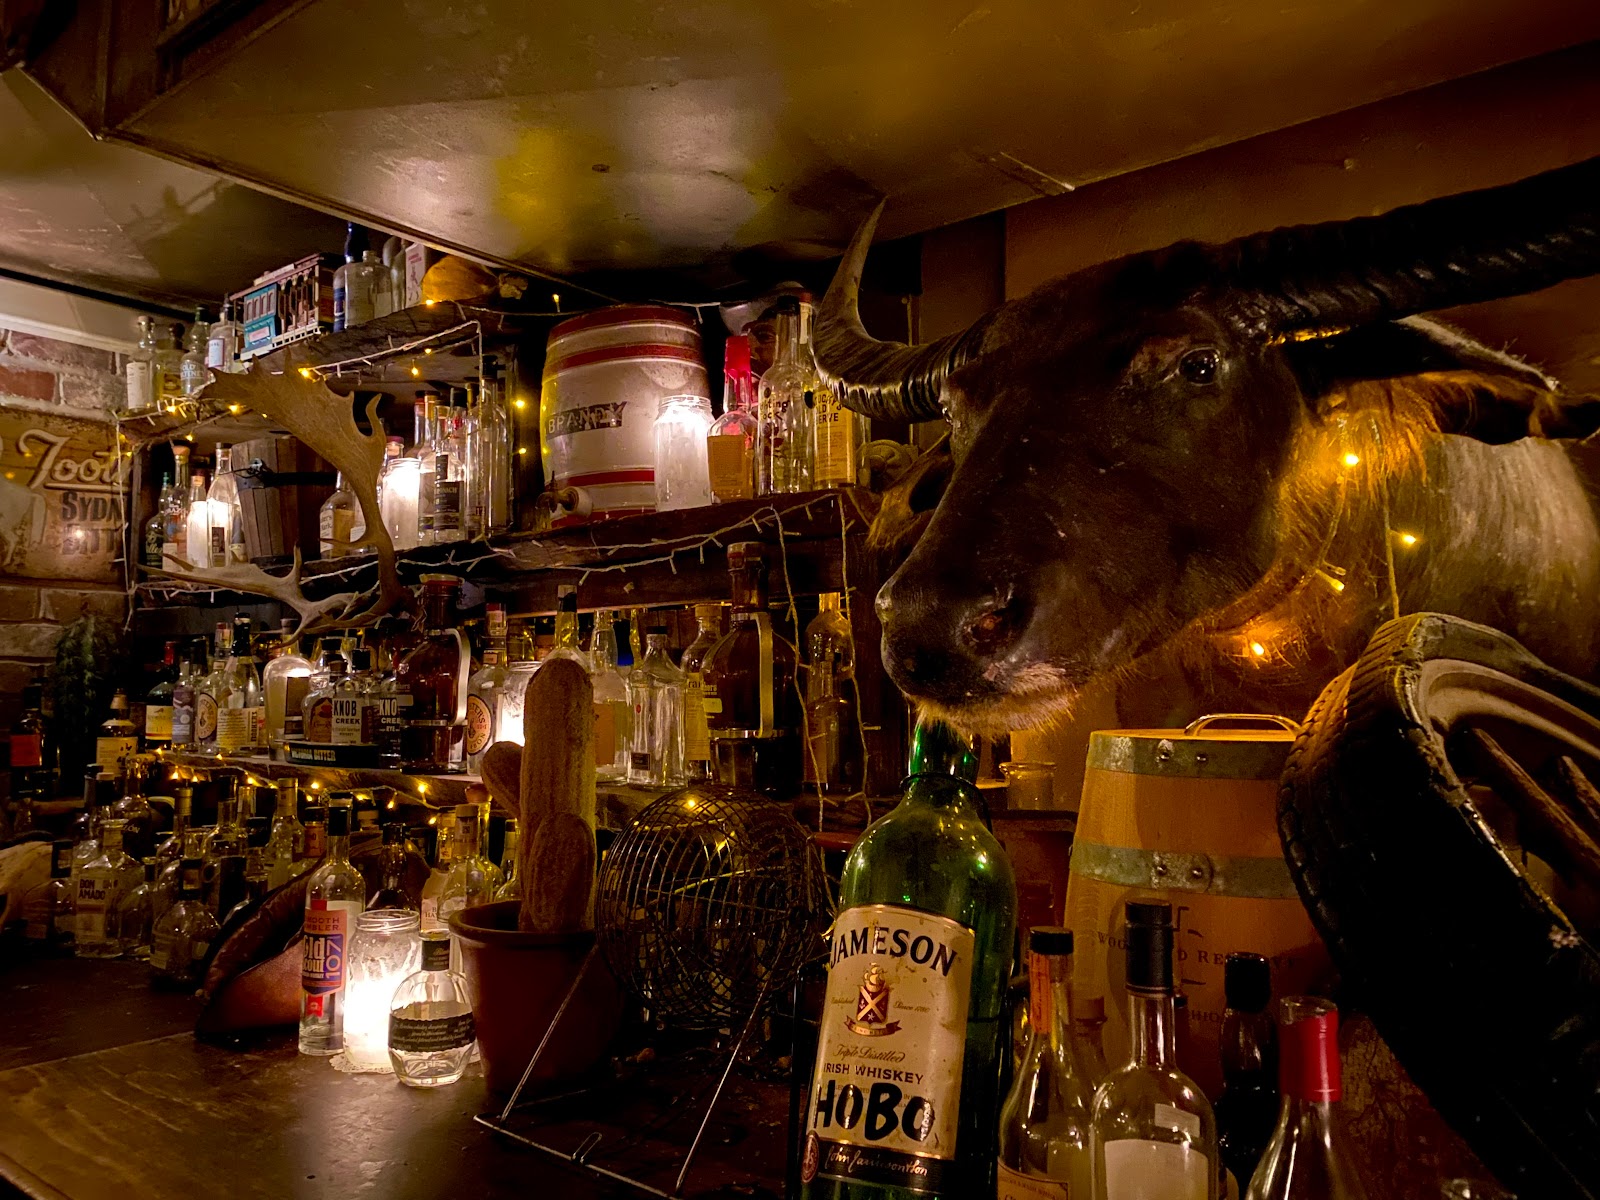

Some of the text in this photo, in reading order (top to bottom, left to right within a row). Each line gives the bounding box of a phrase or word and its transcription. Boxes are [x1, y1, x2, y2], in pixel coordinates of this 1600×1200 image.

[548, 401, 627, 434] BRANDY
[333, 700, 357, 717] KNOB
[380, 698, 397, 716] KNO
[306, 917, 340, 925] MOOTH
[830, 926, 957, 977] JAMESON
[858, 1046, 906, 1063] Distilled
[823, 1062, 924, 1085] IRISH WHISKEY
[813, 1079, 936, 1142] HOBO
